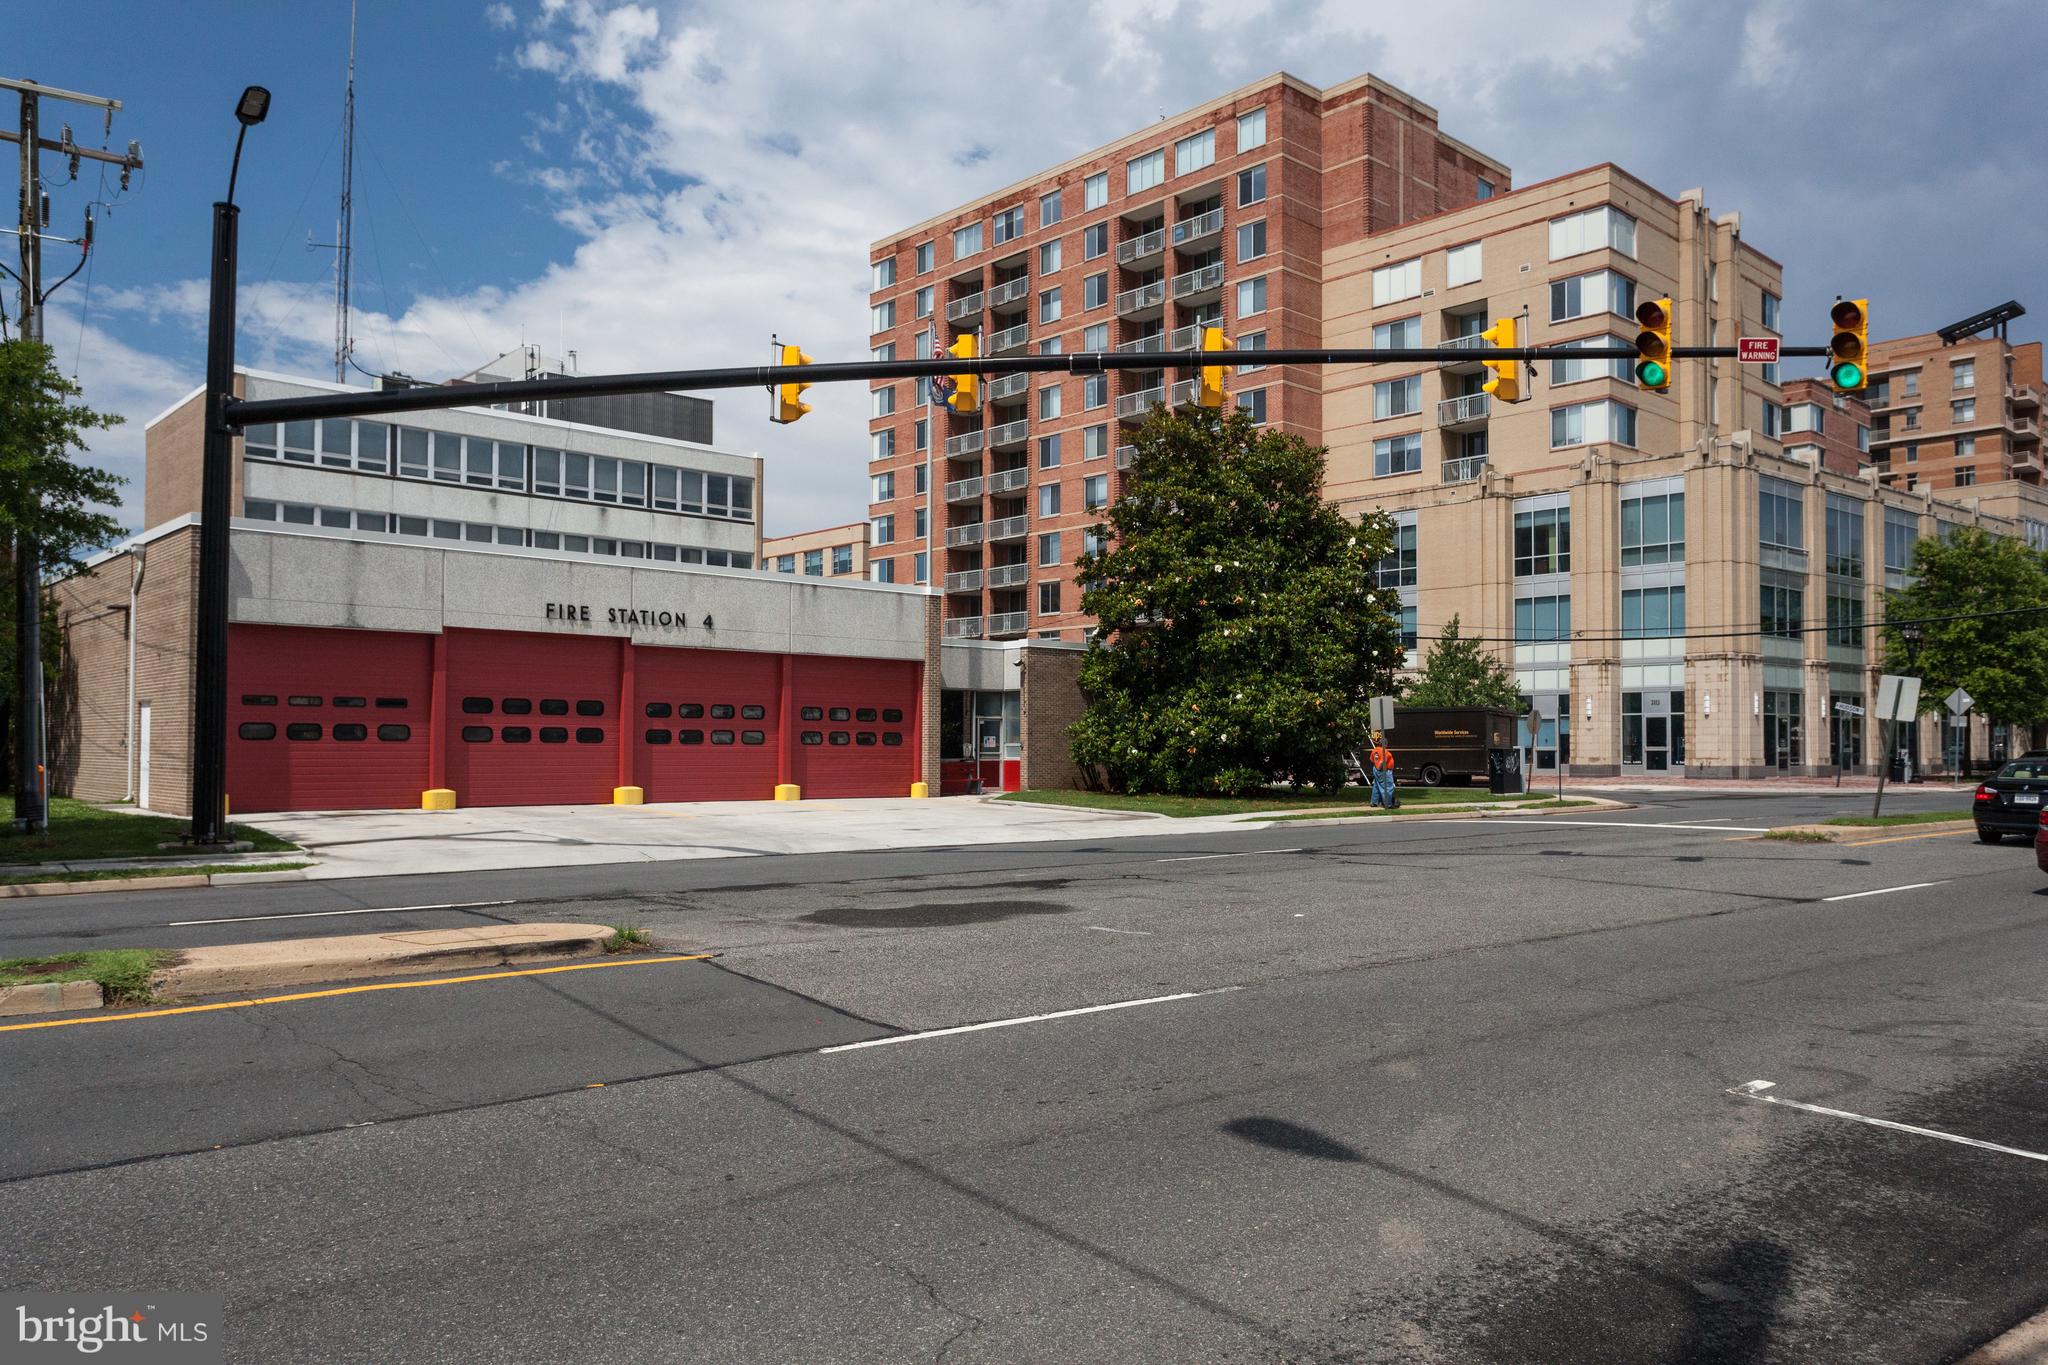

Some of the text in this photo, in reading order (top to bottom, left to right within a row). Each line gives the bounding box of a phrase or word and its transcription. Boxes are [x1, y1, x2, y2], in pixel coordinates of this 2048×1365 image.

[1748, 341, 1768, 350] FIRE
[1741, 351, 1776, 360] WARNING
[546, 603, 713, 630] FIRE STATION 4
